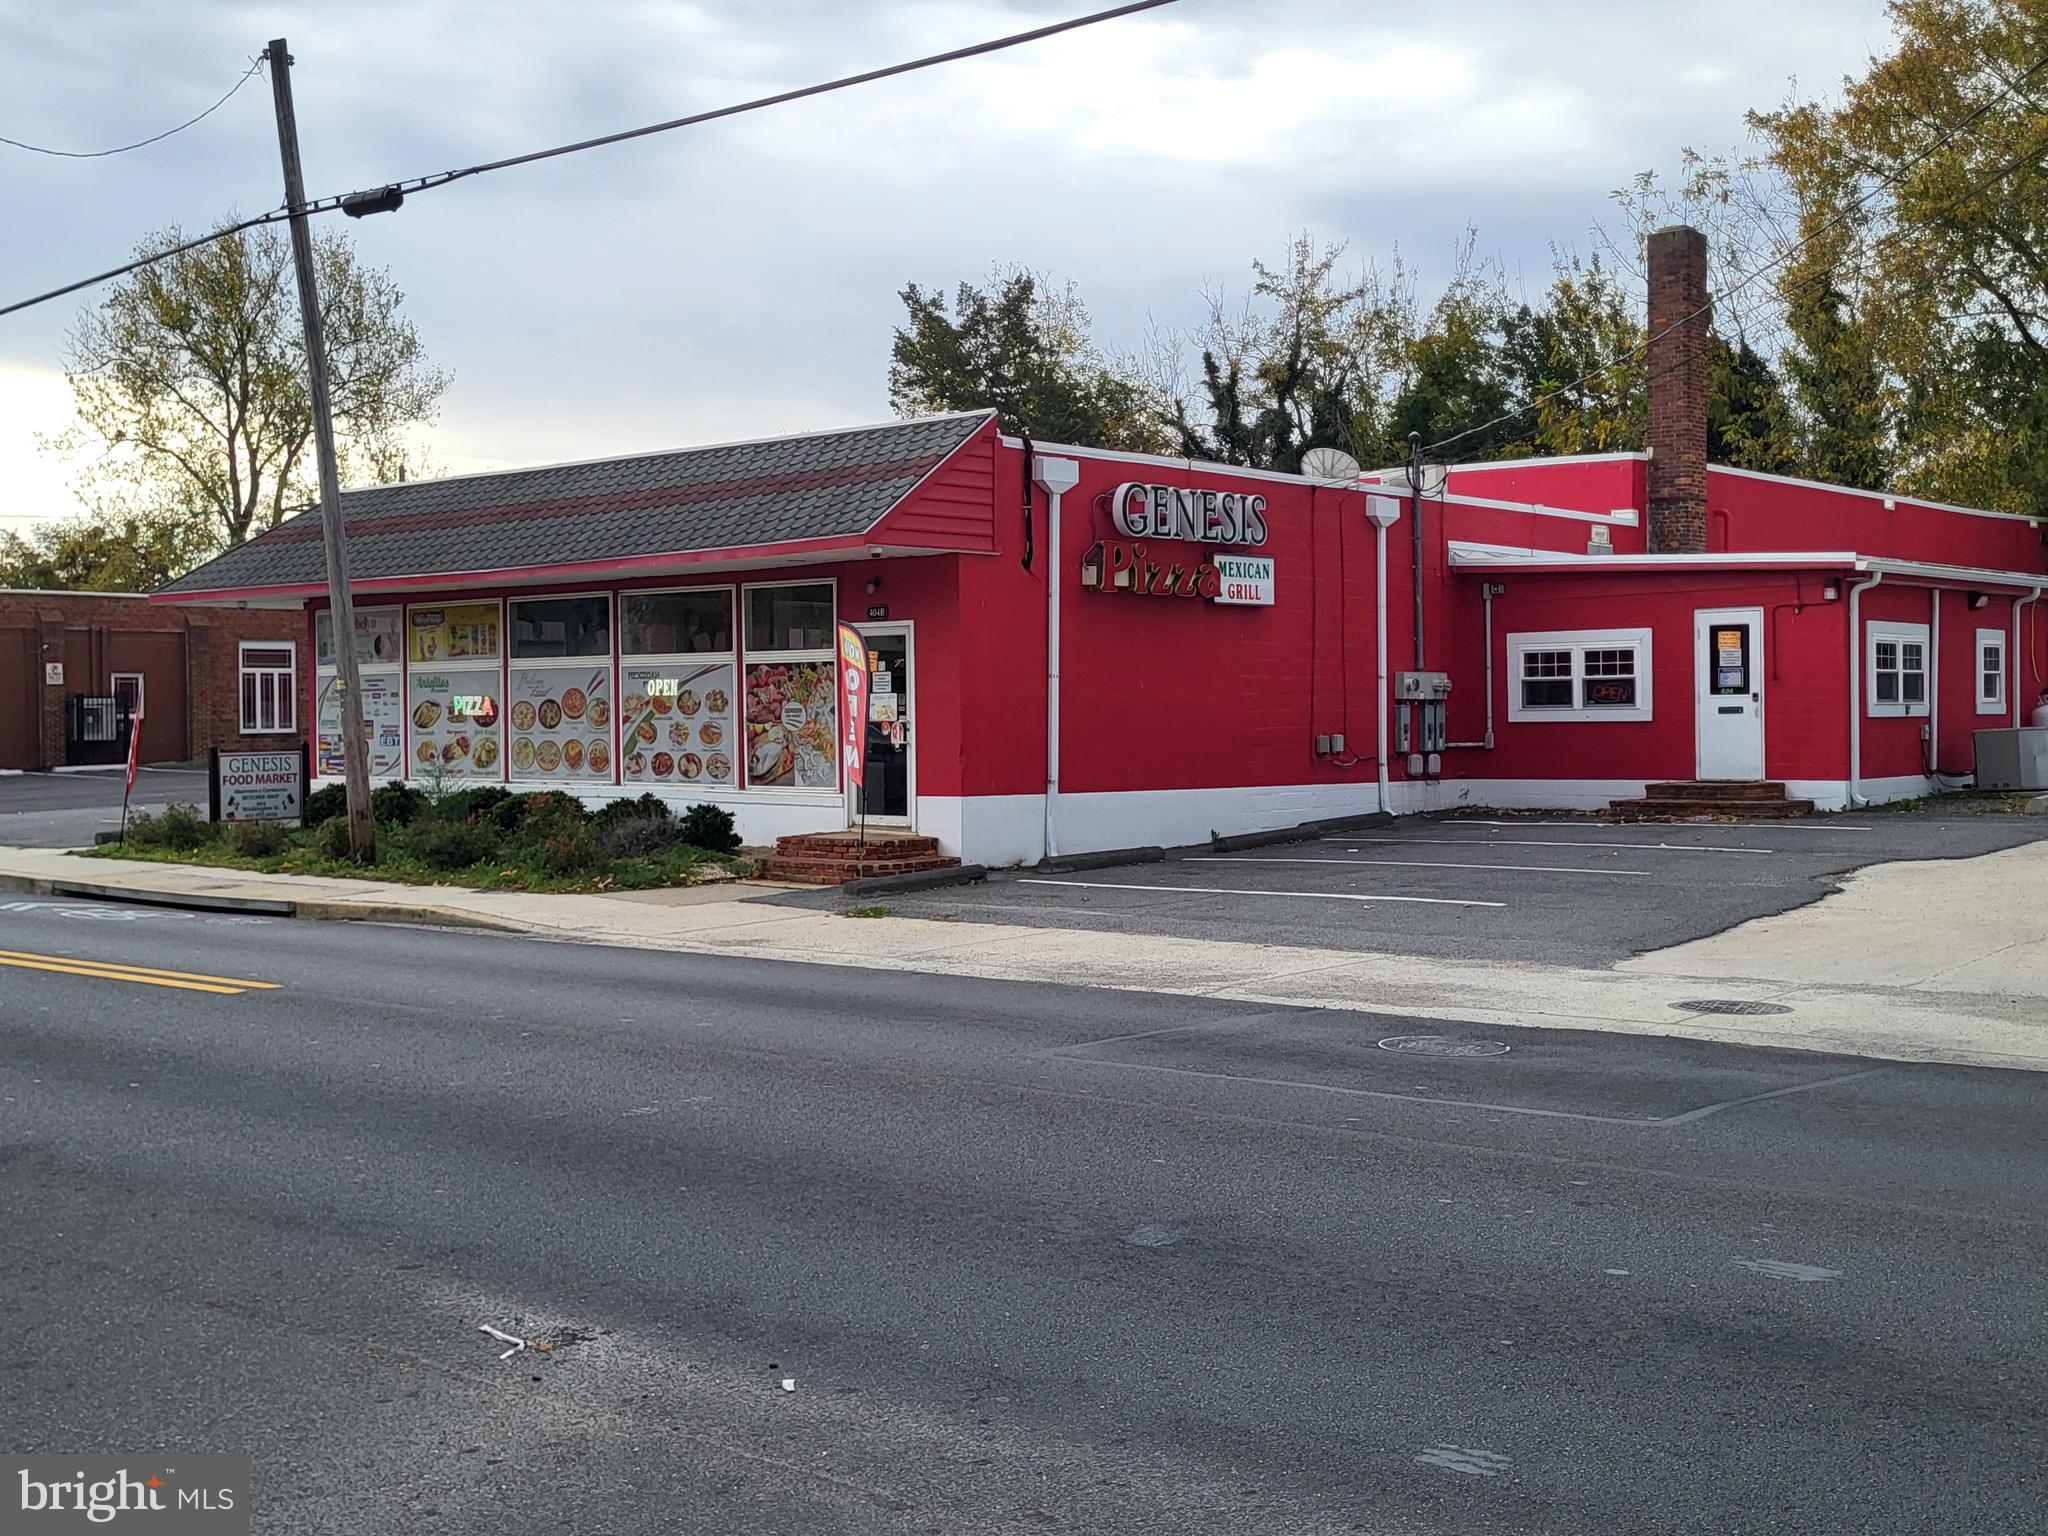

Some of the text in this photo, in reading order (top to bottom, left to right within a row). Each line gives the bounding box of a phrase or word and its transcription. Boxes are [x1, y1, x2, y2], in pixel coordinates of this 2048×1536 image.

[1113, 482, 1268, 546] GENESIS
[1099, 540, 1222, 598] Pizza
[1218, 560, 1270, 580] MEXICAN
[1227, 583, 1262, 601] GRILL
[868, 607, 885, 617] 404B
[647, 678, 679, 696] OPEN
[1592, 685, 1628, 700] OPEN
[453, 695, 494, 716] PIZZA
[229, 756, 292, 773] GENESIS
[222, 772, 298, 786] FOOD MARKET
